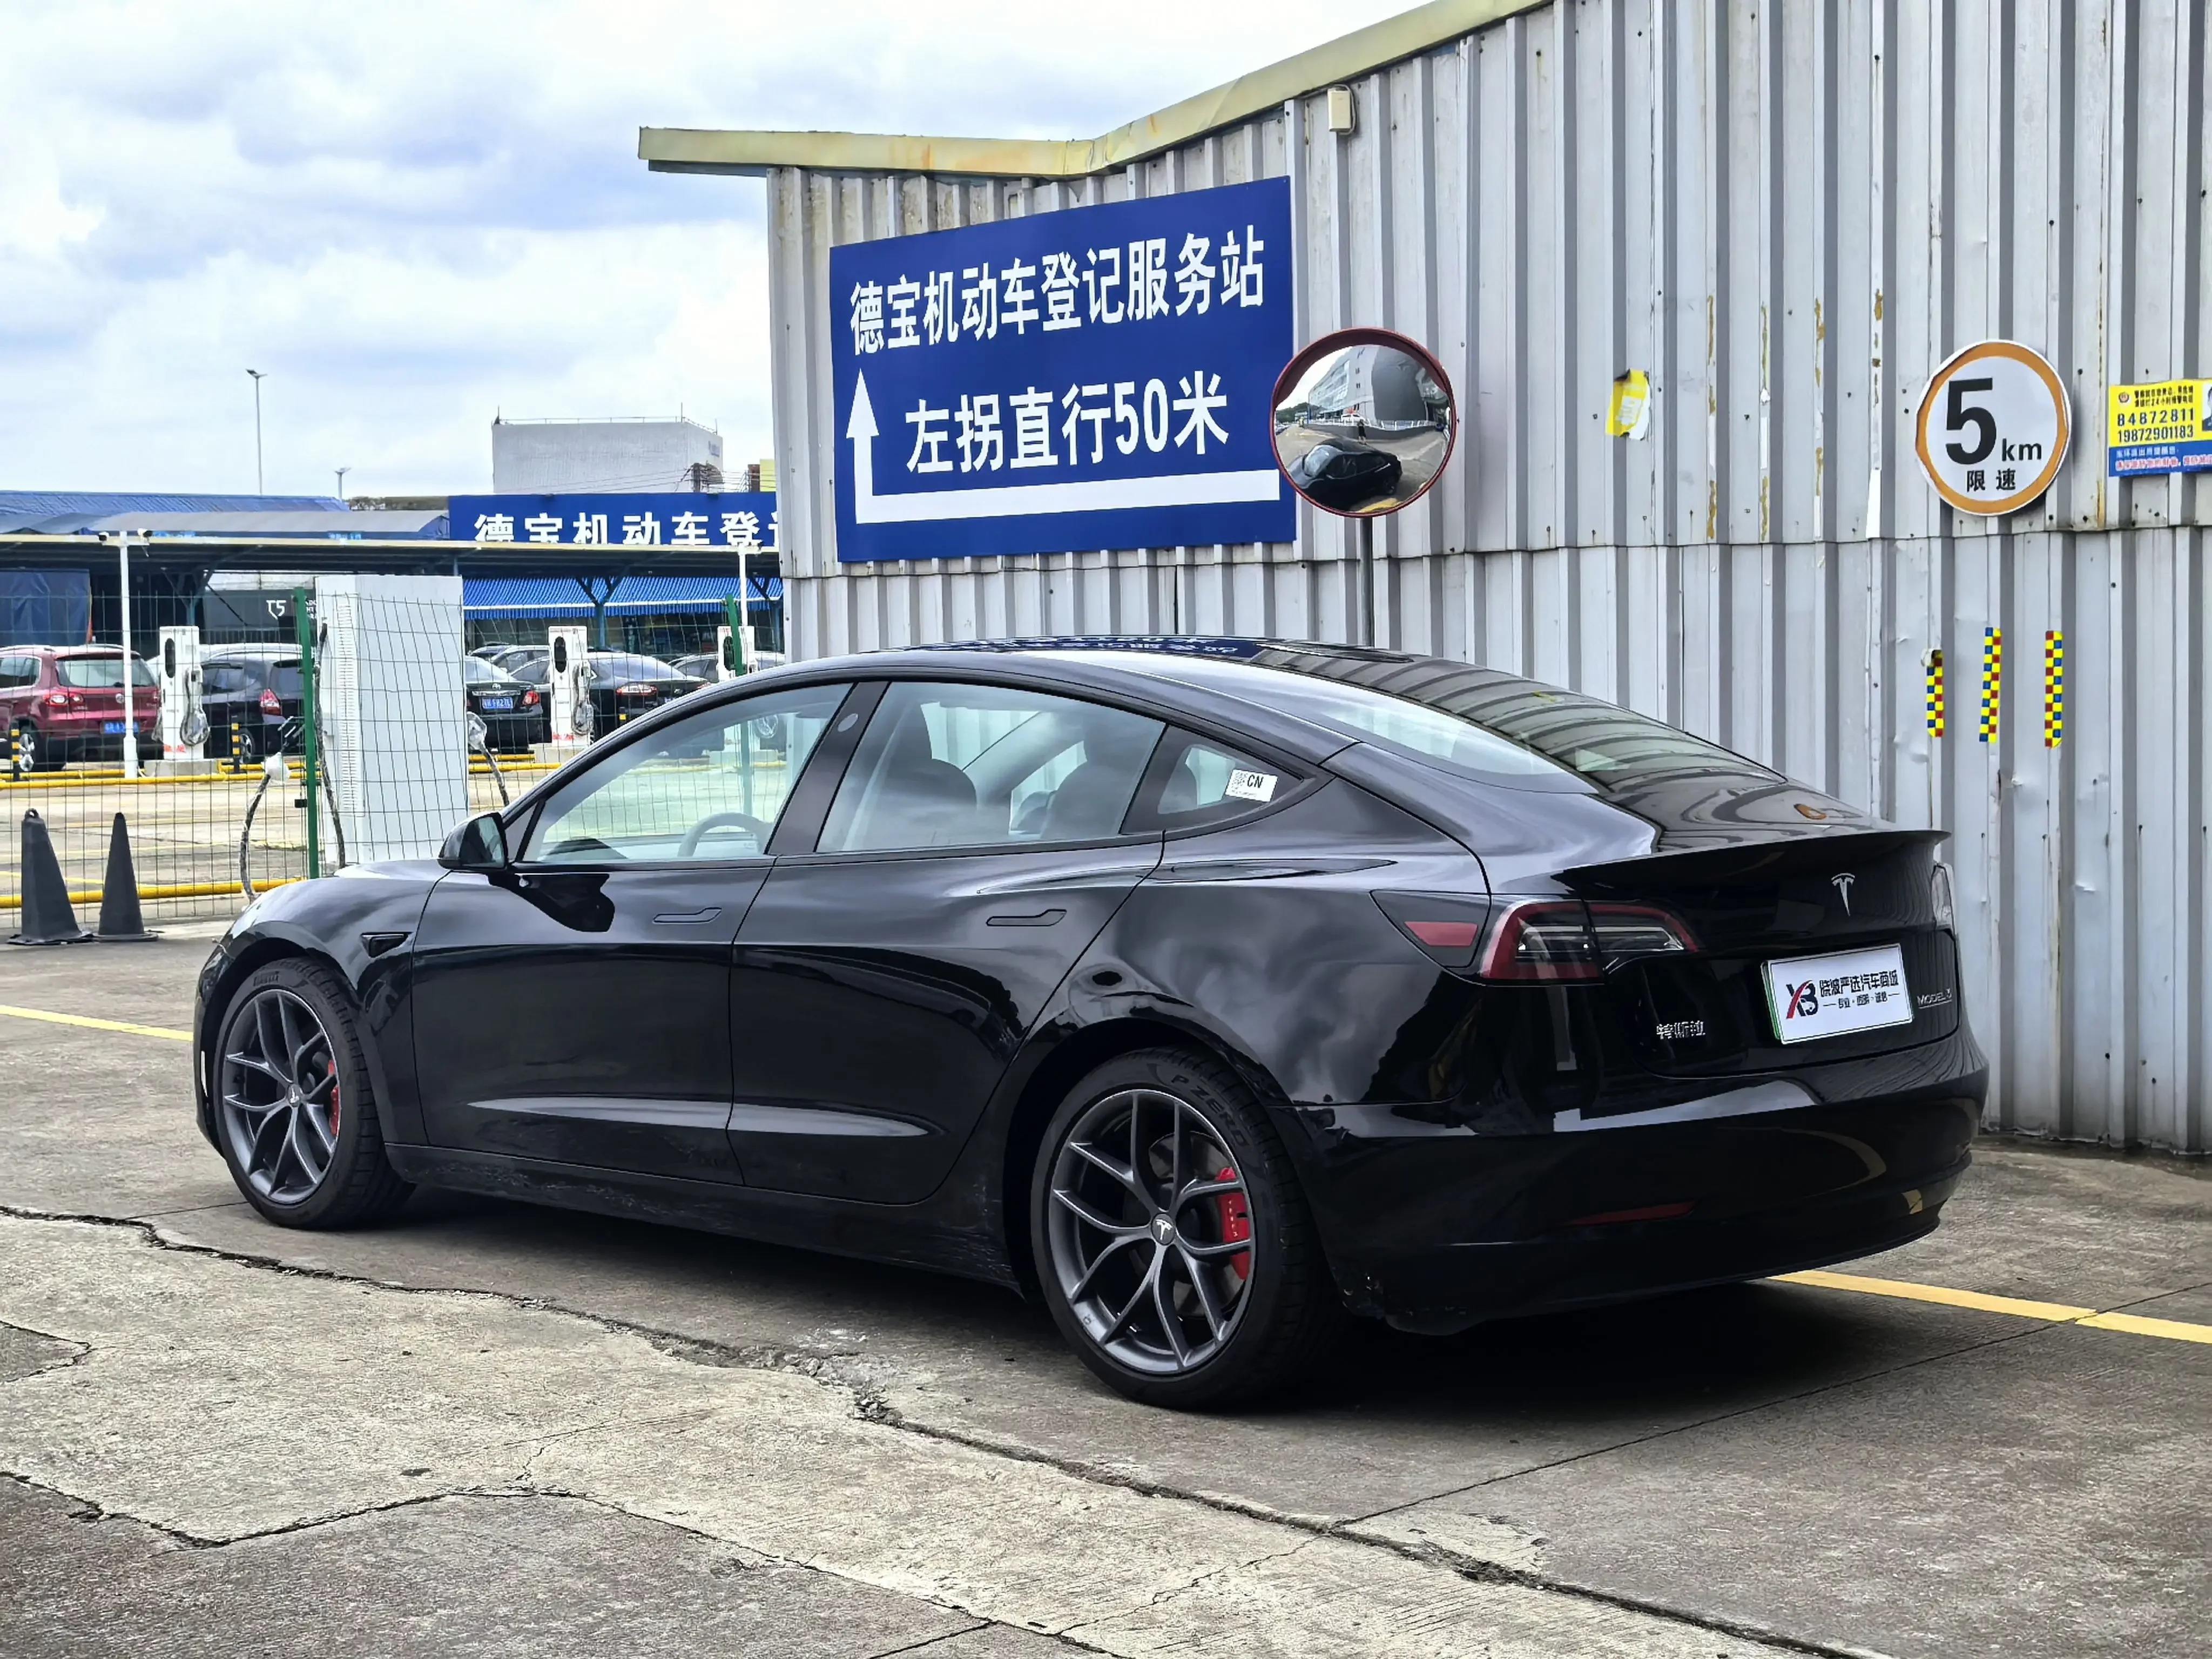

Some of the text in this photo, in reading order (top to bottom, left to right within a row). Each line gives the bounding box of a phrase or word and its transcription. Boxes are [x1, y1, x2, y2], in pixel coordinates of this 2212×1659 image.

[849, 224, 1265, 356] 德宝机动车登记服务站
[905, 370, 1229, 474] 左拐直行50米
[1946, 377, 2042, 465] 5 km
[2117, 408, 2194, 427] 84872811
[2118, 424, 2194, 443] 19872901183
[1966, 468, 2016, 492] 限速
[1247, 774, 1264, 788] CN
[1656, 1020, 1705, 1040] 特斯拉
